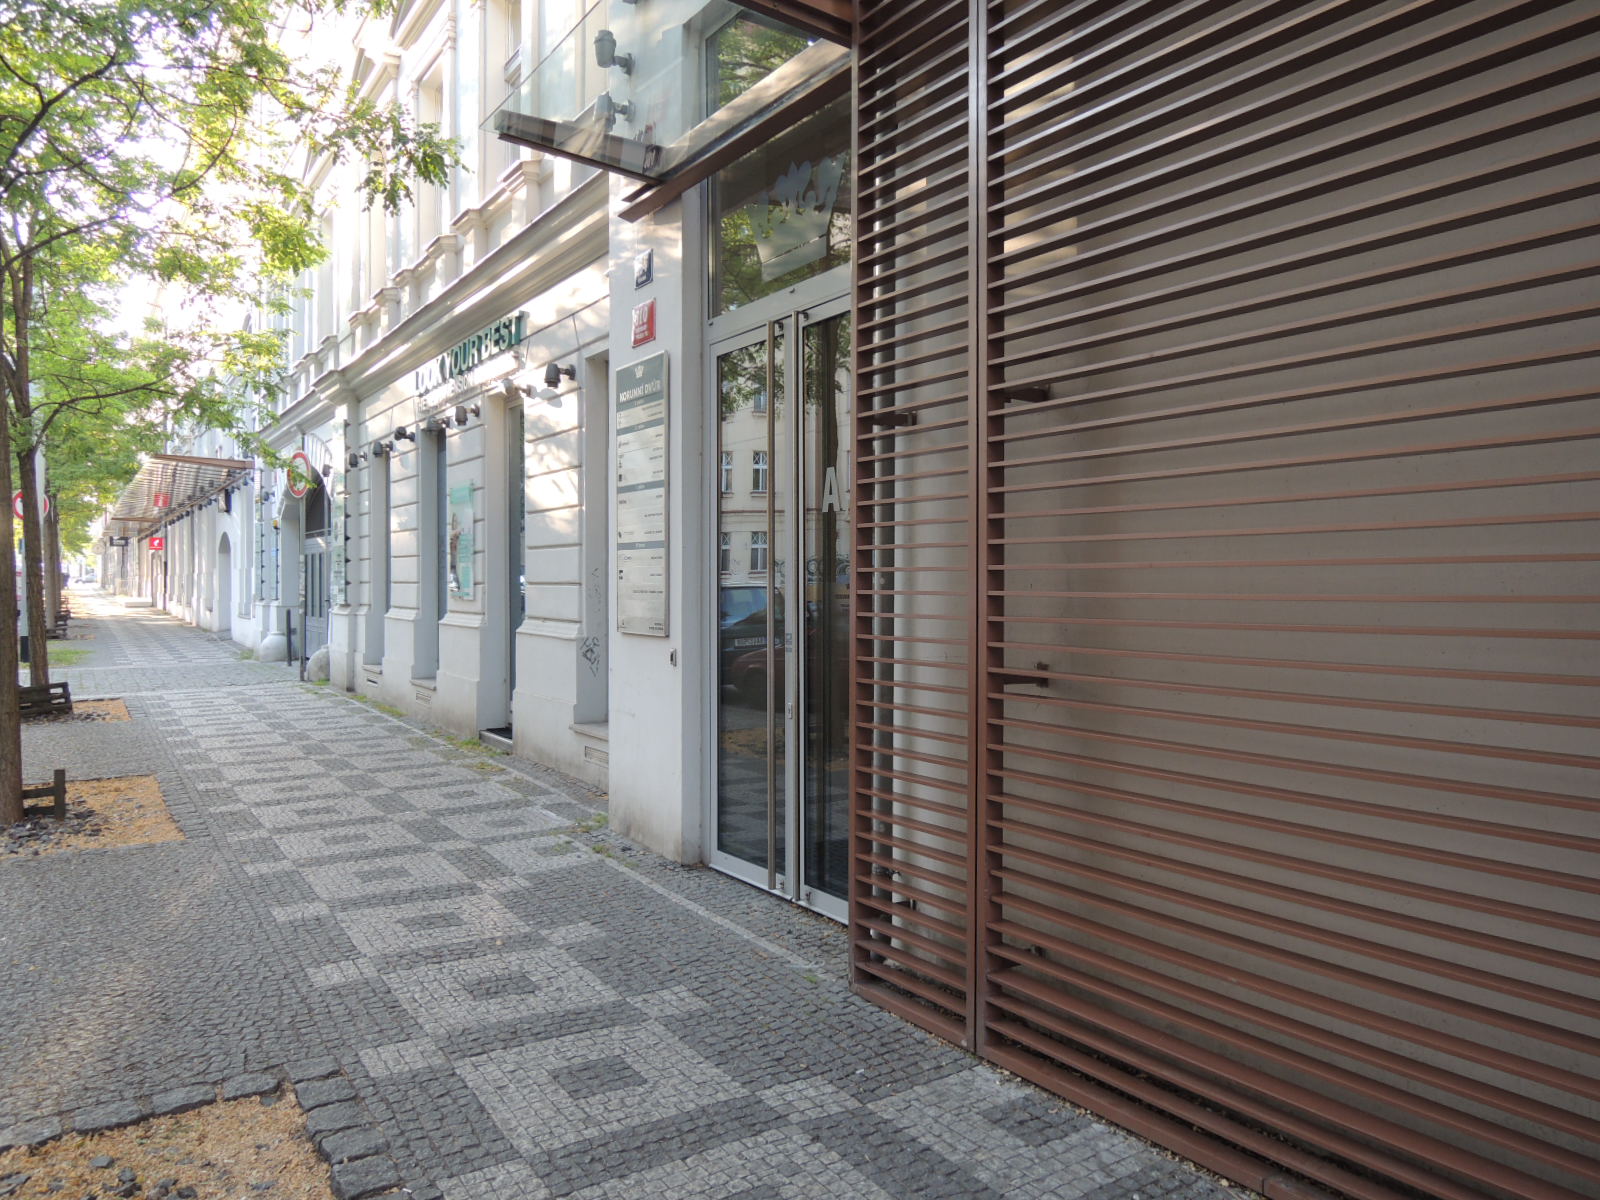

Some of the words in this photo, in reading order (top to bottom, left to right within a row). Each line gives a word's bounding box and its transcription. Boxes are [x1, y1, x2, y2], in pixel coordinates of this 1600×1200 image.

[443, 334, 478, 380] YOUR
[481, 313, 523, 360] BEST
[822, 466, 840, 512] A
